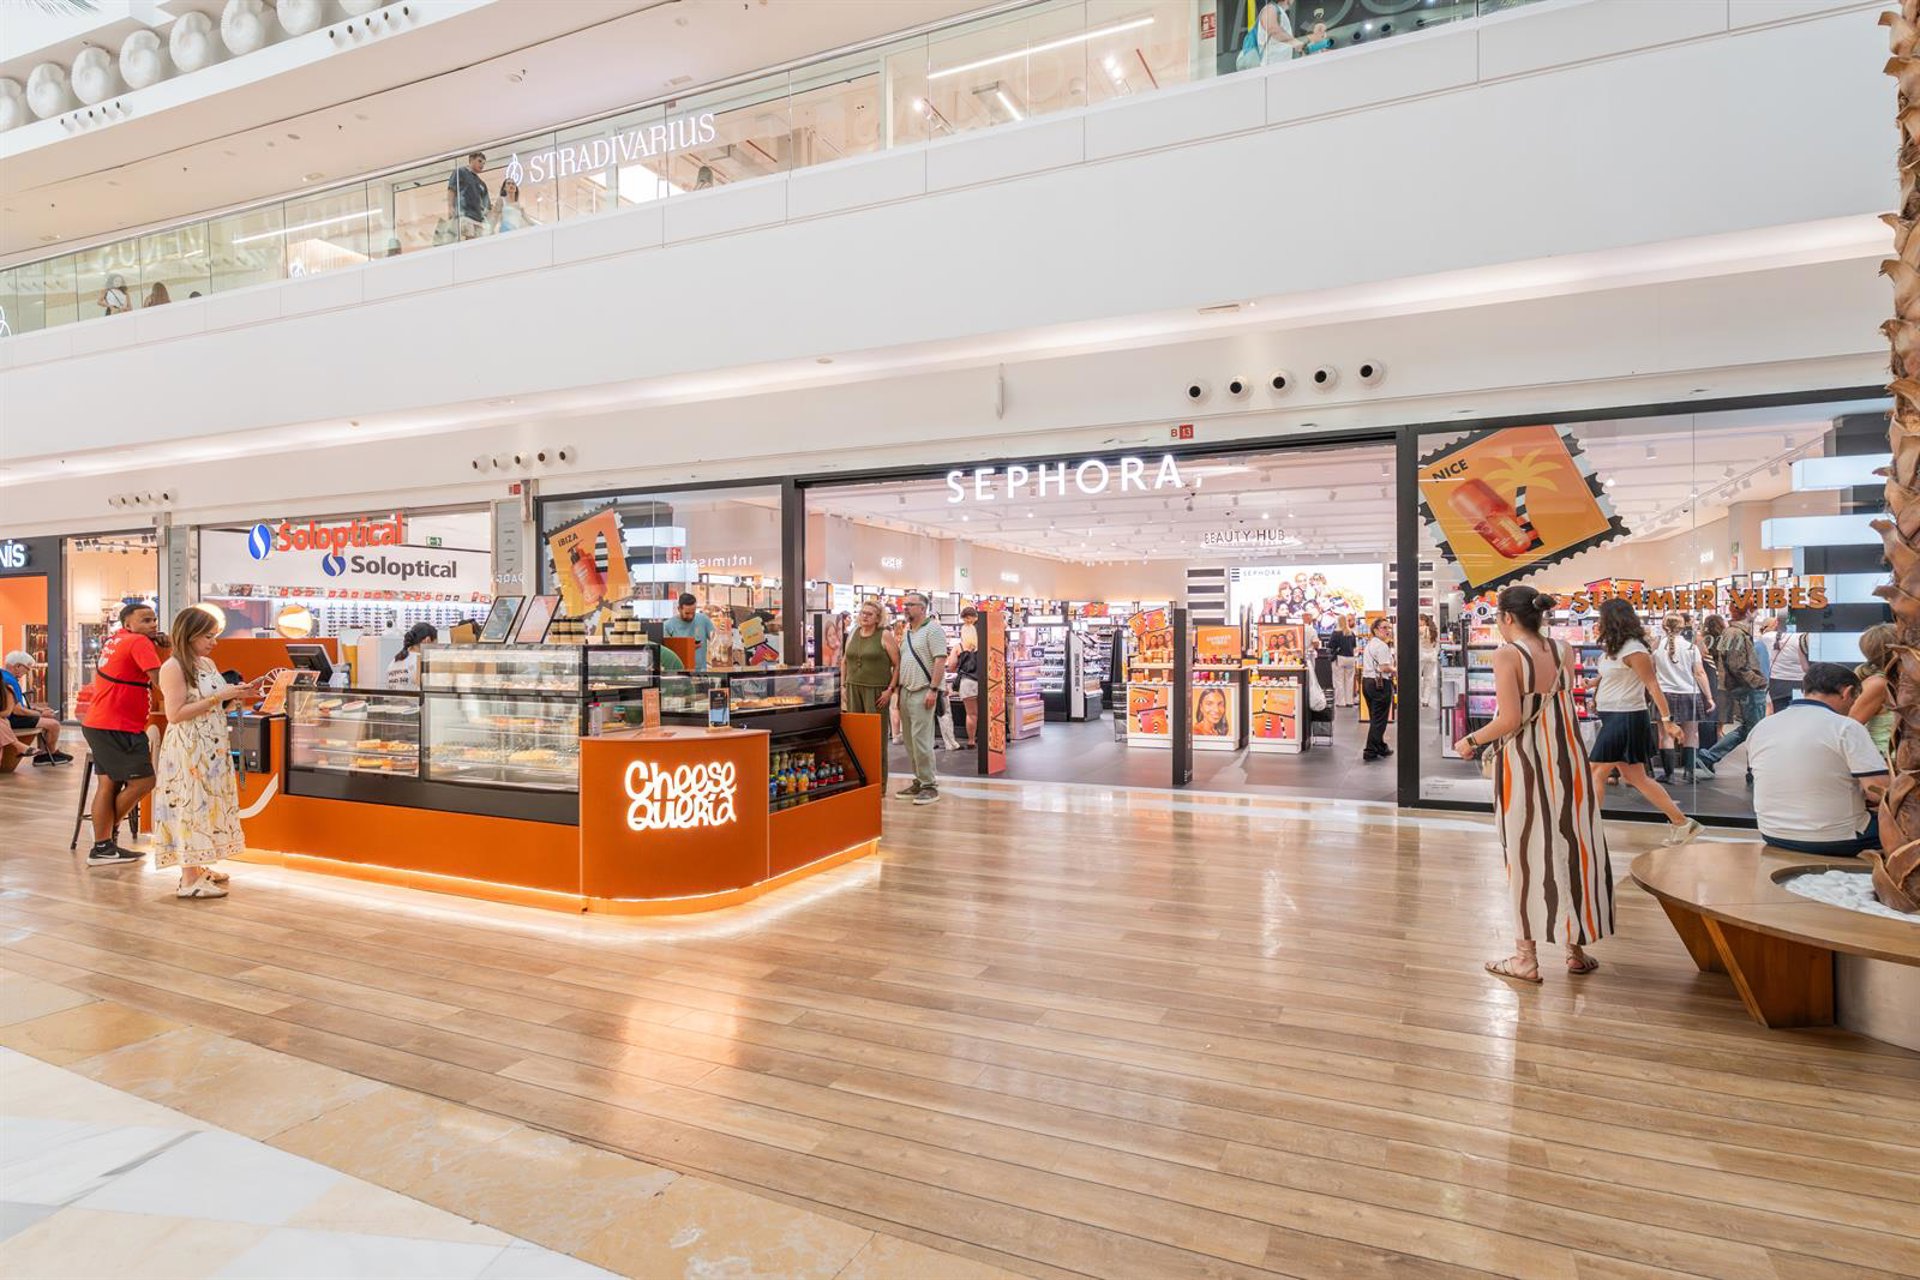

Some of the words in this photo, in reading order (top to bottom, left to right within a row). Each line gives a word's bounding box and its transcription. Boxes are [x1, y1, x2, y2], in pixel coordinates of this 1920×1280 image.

[529, 113, 716, 184] STRADIVARIUS
[946, 454, 1183, 504] SEPHORA
[1432, 459, 1469, 483] NICE
[277, 511, 405, 558] Soloptical
[558, 532, 578, 547] IBIZA
[1204, 530, 1251, 545] BEAUTY
[1257, 528, 1286, 542] HUB
[351, 555, 457, 581] Soloptical
[1243, 569, 1282, 578] SEPHORA
[1572, 586, 1716, 614] SUMMER
[1727, 586, 1830, 610] VIBES
[624, 760, 738, 800] Cheese
